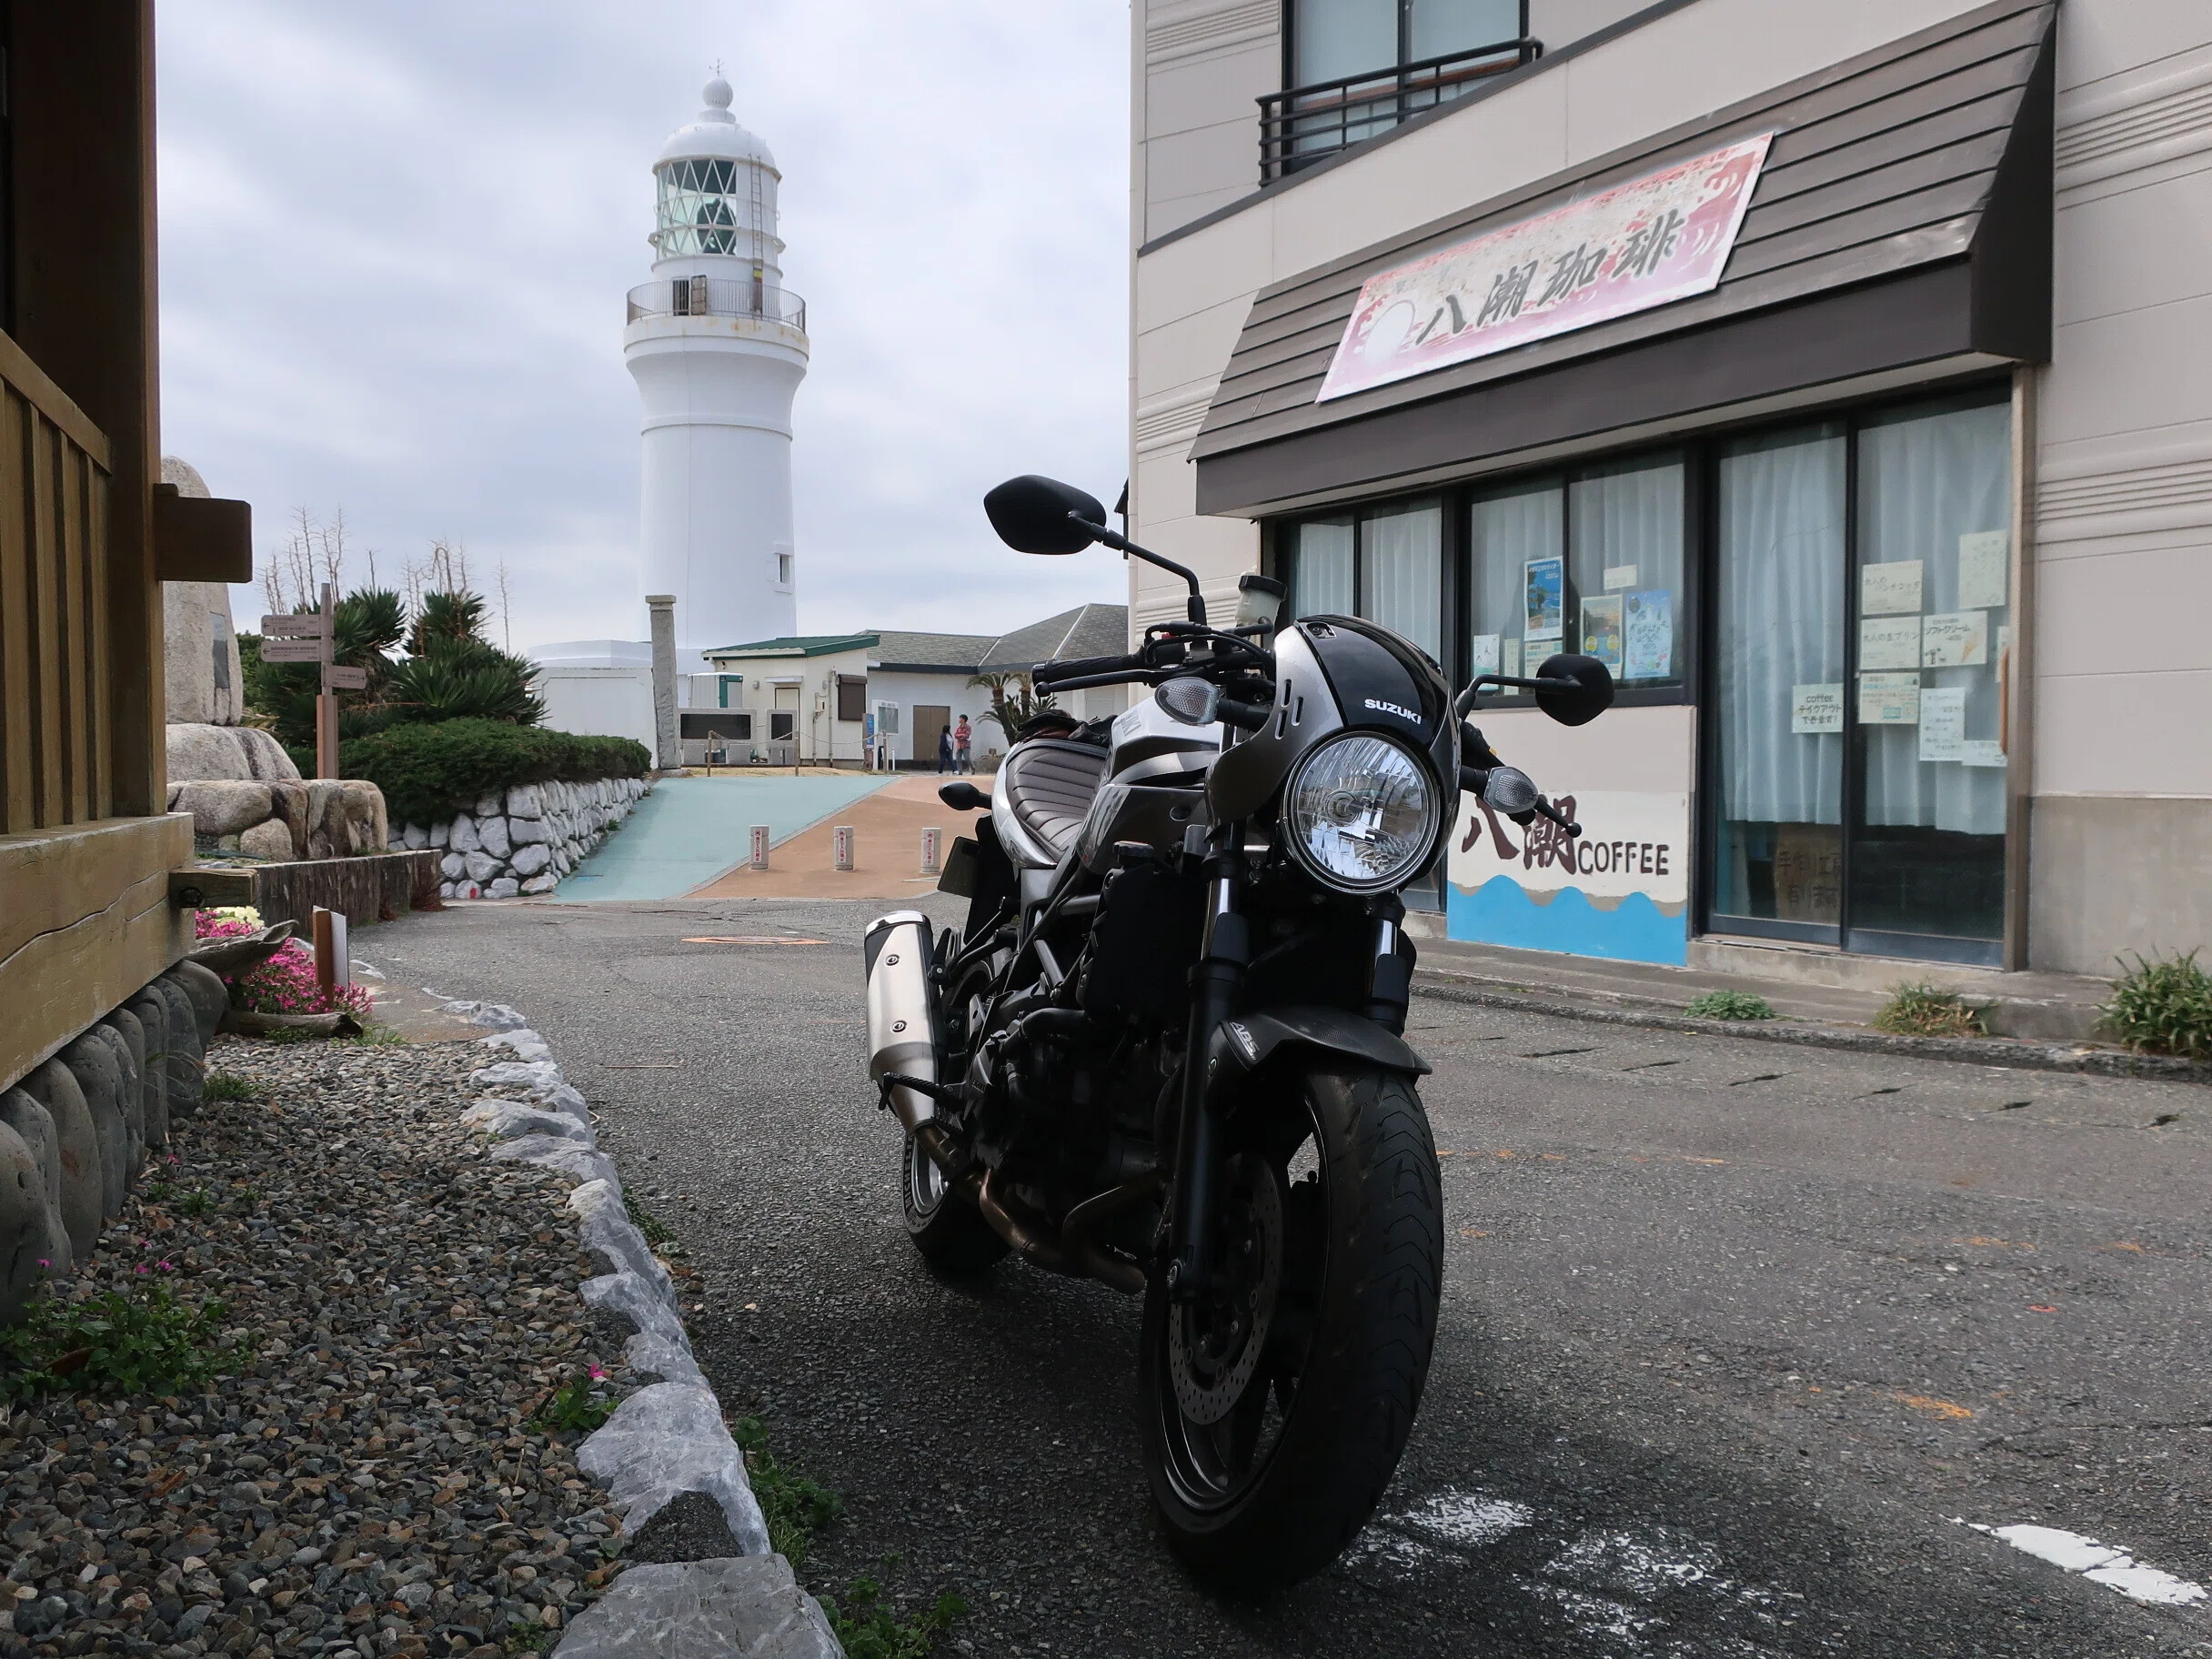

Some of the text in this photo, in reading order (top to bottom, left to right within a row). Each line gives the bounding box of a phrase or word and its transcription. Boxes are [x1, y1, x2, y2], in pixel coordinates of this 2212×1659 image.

[1415, 208, 1685, 346] 八潮珈琲
[1364, 699, 1422, 725] SUZUKI
[1798, 703, 1843, 714] テイクアウト
[1806, 694, 1835, 703] coffee
[1578, 840, 1670, 876] COFFEE
[1232, 1021, 1262, 1055] ABS
